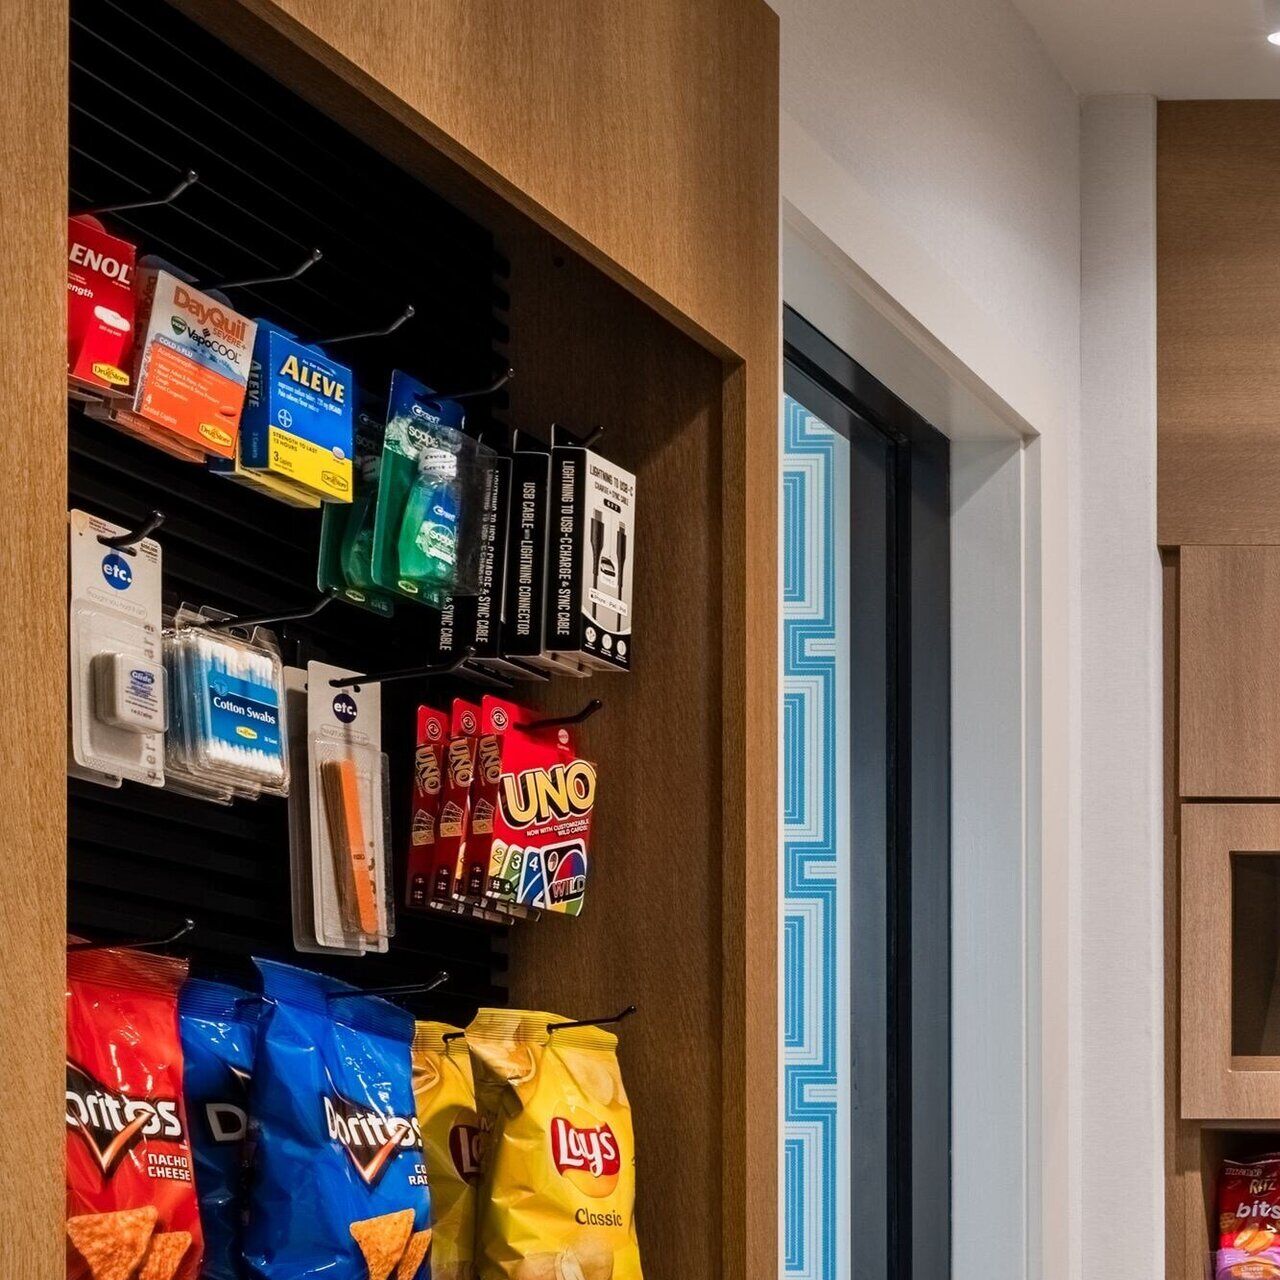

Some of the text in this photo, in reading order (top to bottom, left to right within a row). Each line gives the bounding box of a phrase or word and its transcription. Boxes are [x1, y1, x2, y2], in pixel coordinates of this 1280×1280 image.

[69, 243, 132, 285] ENOL
[173, 286, 248, 338] DayQuil
[186, 322, 241, 365] VapoCOOL
[281, 355, 345, 403] ALEVE
[103, 563, 132, 583] etc.
[517, 482, 535, 635] USB CABLE LIGHTNING CONNECTOR
[213, 696, 276, 725] Cotton Swabs
[334, 702, 357, 717] etc.
[499, 760, 597, 830] UNO
[529, 856, 538, 872] 4
[551, 876, 585, 899] WILD
[324, 1097, 425, 1149] Doritos
[147, 1153, 188, 1168] NACHO
[557, 1124, 616, 1176] Lay's
[147, 1166, 191, 1182] CHEESE
[574, 1207, 623, 1228] Classic
